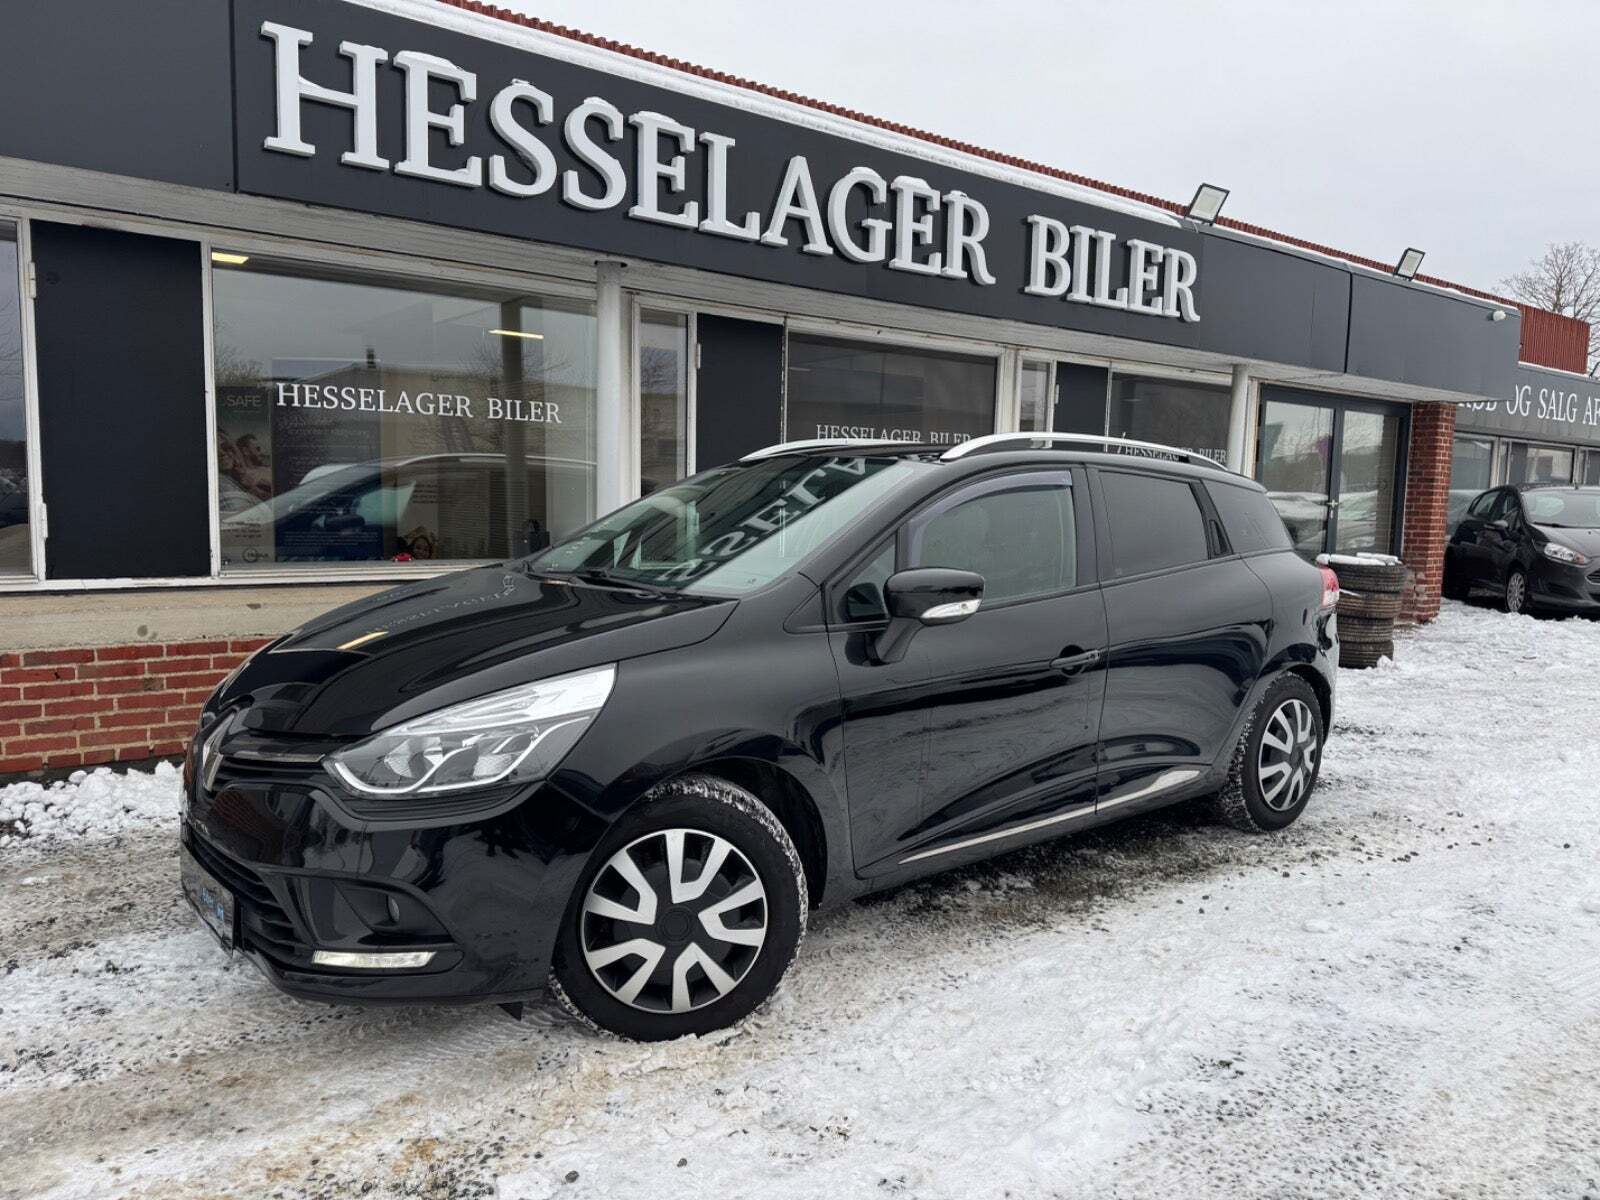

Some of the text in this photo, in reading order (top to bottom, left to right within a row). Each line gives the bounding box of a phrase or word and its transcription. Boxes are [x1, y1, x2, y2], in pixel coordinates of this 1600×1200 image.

[260, 20, 1201, 323] HESSELAGER BILER
[225, 394, 263, 408] SAFE
[276, 382, 562, 424] HESSELAGER BILER
[1537, 388, 1578, 423] SALG
